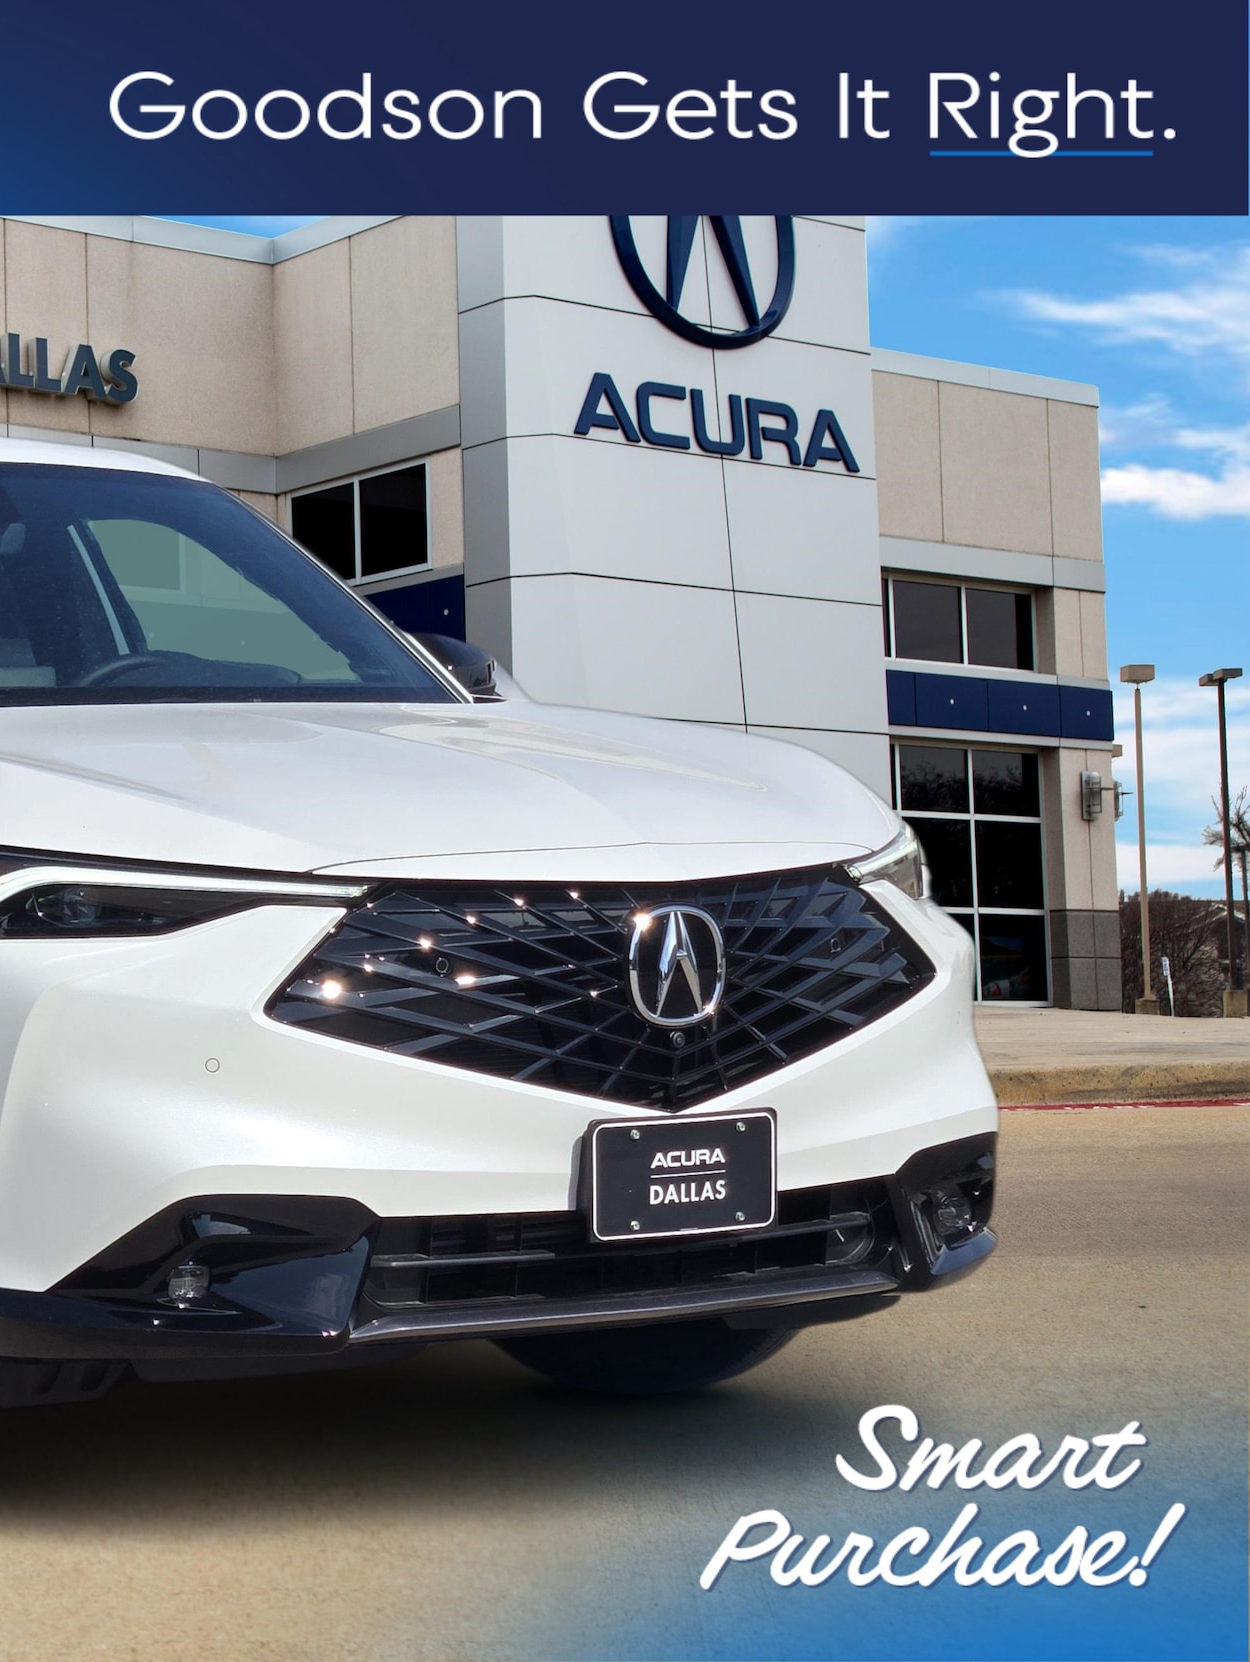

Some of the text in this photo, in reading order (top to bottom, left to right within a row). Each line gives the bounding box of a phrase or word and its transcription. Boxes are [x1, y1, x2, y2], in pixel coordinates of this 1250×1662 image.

[573, 372, 860, 474] ACURA
[650, 1147, 726, 1169] ACURA
[649, 1179, 727, 1205] DALLAS
